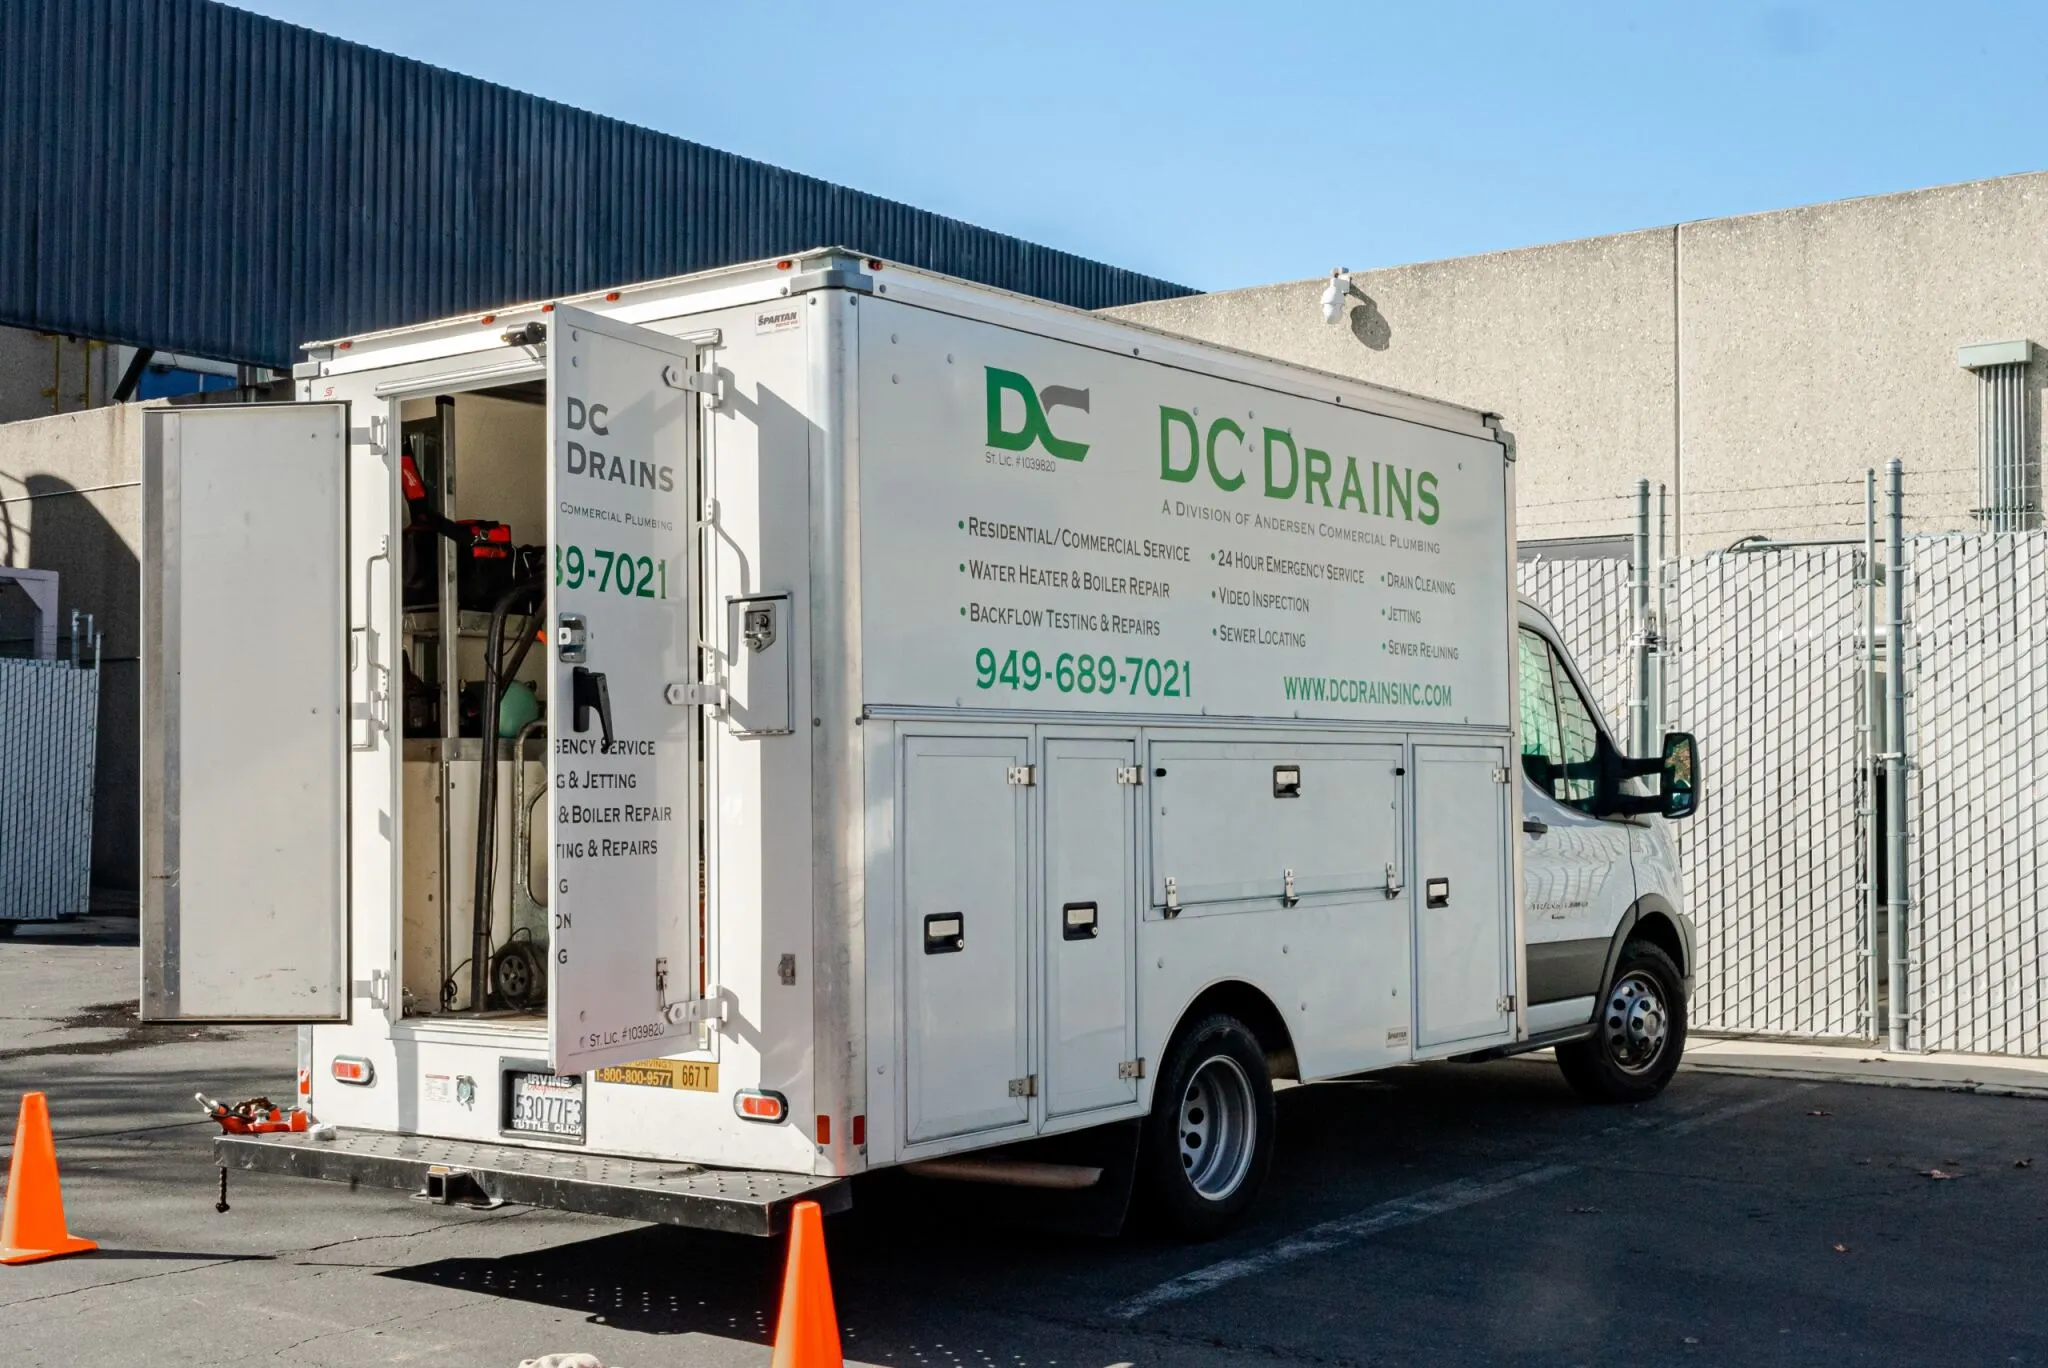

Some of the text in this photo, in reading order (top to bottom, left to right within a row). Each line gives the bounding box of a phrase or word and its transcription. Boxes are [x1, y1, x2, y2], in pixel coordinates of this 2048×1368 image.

[758, 311, 797, 326] SPARTAN
[567, 396, 609, 436] DC
[984, 365, 1090, 462] DC
[567, 440, 674, 493] DRAINS
[1016, 455, 1056, 473] #1039820
[1159, 404, 1440, 526] DC DRAINS
[560, 501, 673, 532] COMMERCIAL PLUMBING
[1161, 499, 1441, 554] A DIVISION OF ANDERSEN COMMERCIAL PLUMBING
[969, 516, 1191, 563] RESIDENTIAL/COMMERCIAL SERVICE
[969, 559, 1170, 599] WATER HEATER & BOILER REPAIR
[1218, 549, 1365, 584] 24 HOUR EMERGENCY SERVICE
[1387, 572, 1456, 596] DRAIN CLEANING
[1219, 587, 1310, 613] VIDEO INSPECTION
[970, 602, 1160, 637] BACKFLOW TESTING & REPAIRS
[1387, 606, 1422, 624] JETTING
[1219, 625, 1306, 648] SEWER LOCATING
[1388, 639, 1418, 657] SEWER
[975, 647, 1191, 698] 949-689-7021
[1283, 676, 1452, 707] WWW.DCDRAINSINC.COM
[568, 770, 579, 789] &
[582, 770, 637, 789] JETTING
[558, 804, 672, 824] & BOILER REPAIR
[588, 839, 598, 858] &
[602, 838, 658, 857] REPAIRS
[622, 1022, 665, 1041] #1039820
[527, 1073, 572, 1088] IRVINE
[594, 1064, 710, 1088] 1-800-800-9577 667 T
[512, 1119, 582, 1135] TUTTLE CLICK
